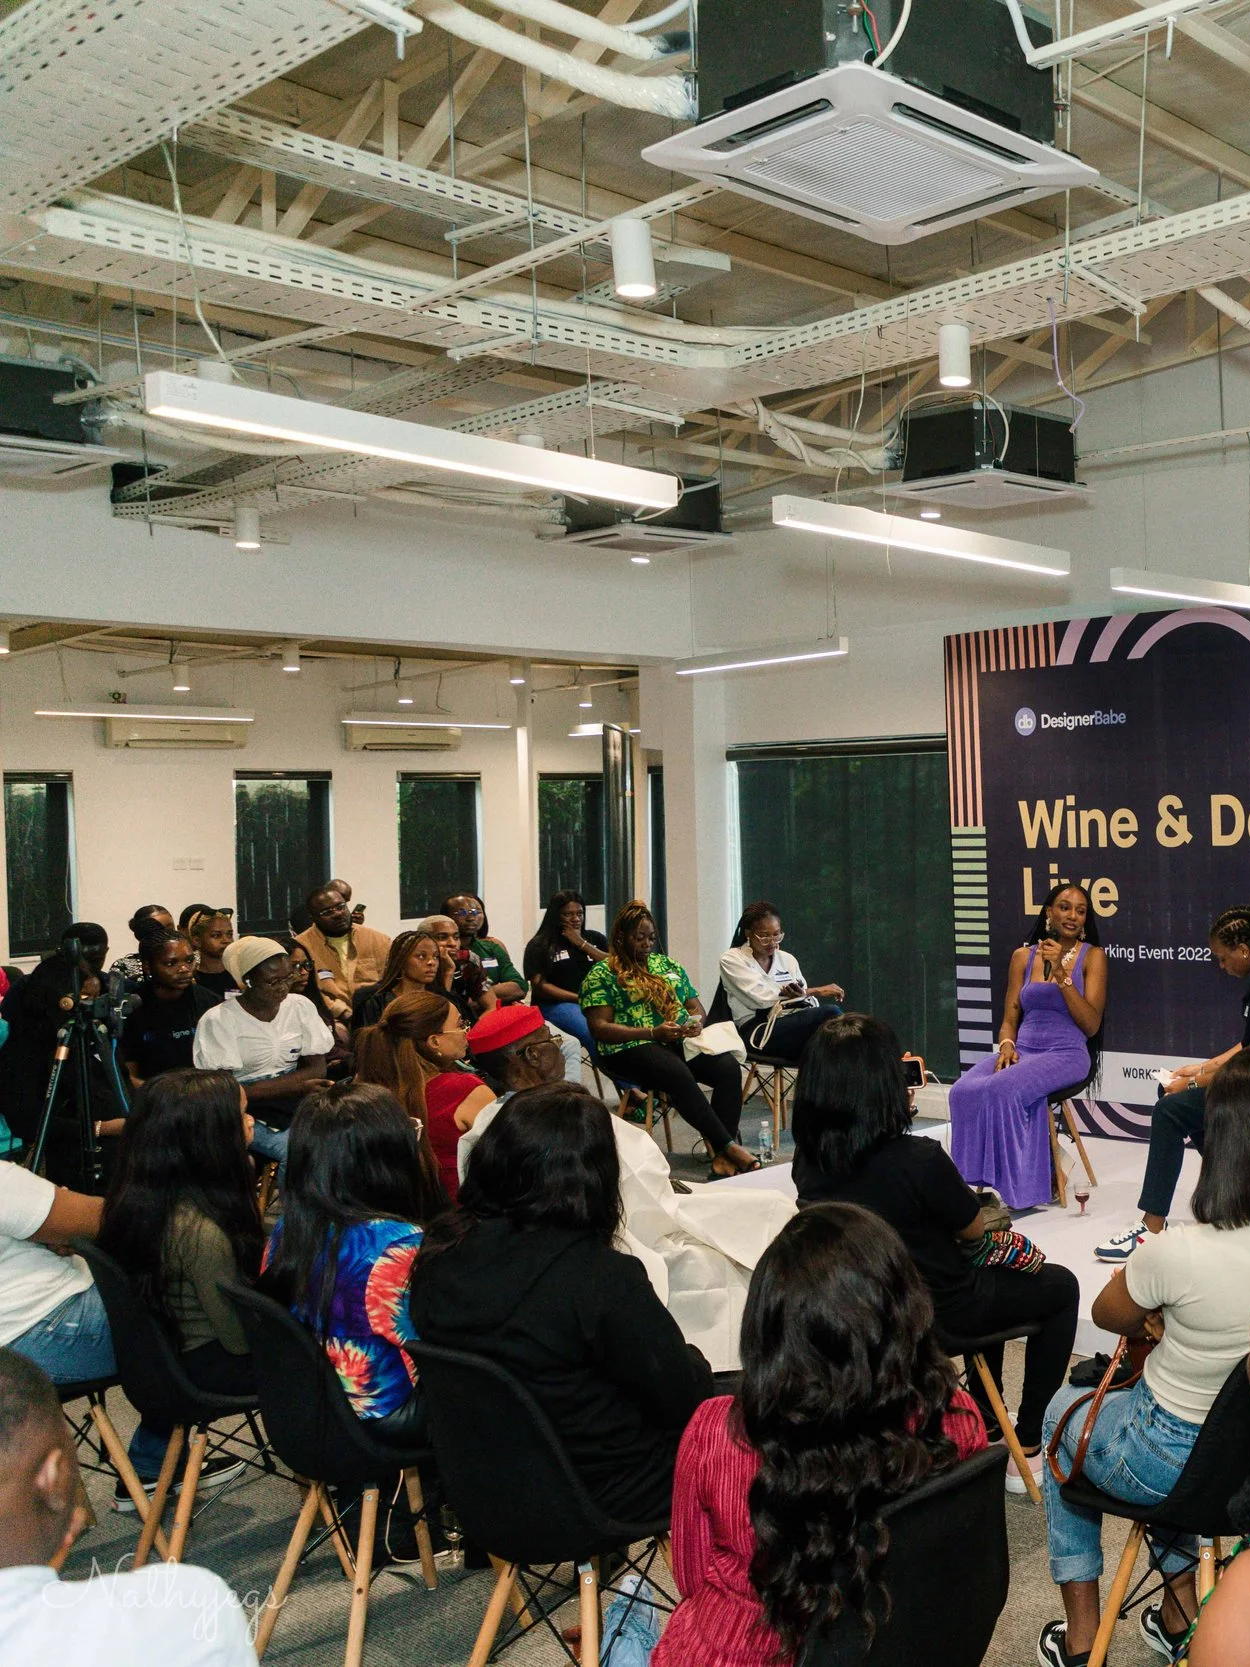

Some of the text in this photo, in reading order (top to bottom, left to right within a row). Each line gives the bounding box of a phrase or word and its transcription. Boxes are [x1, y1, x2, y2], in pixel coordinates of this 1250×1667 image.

[1041, 709, 1127, 731] DesignerBabe
[1018, 795, 1139, 849] Wine
[1155, 794, 1193, 848] &
[1138, 945, 1174, 960] Event
[1178, 946, 1212, 962] 2022
